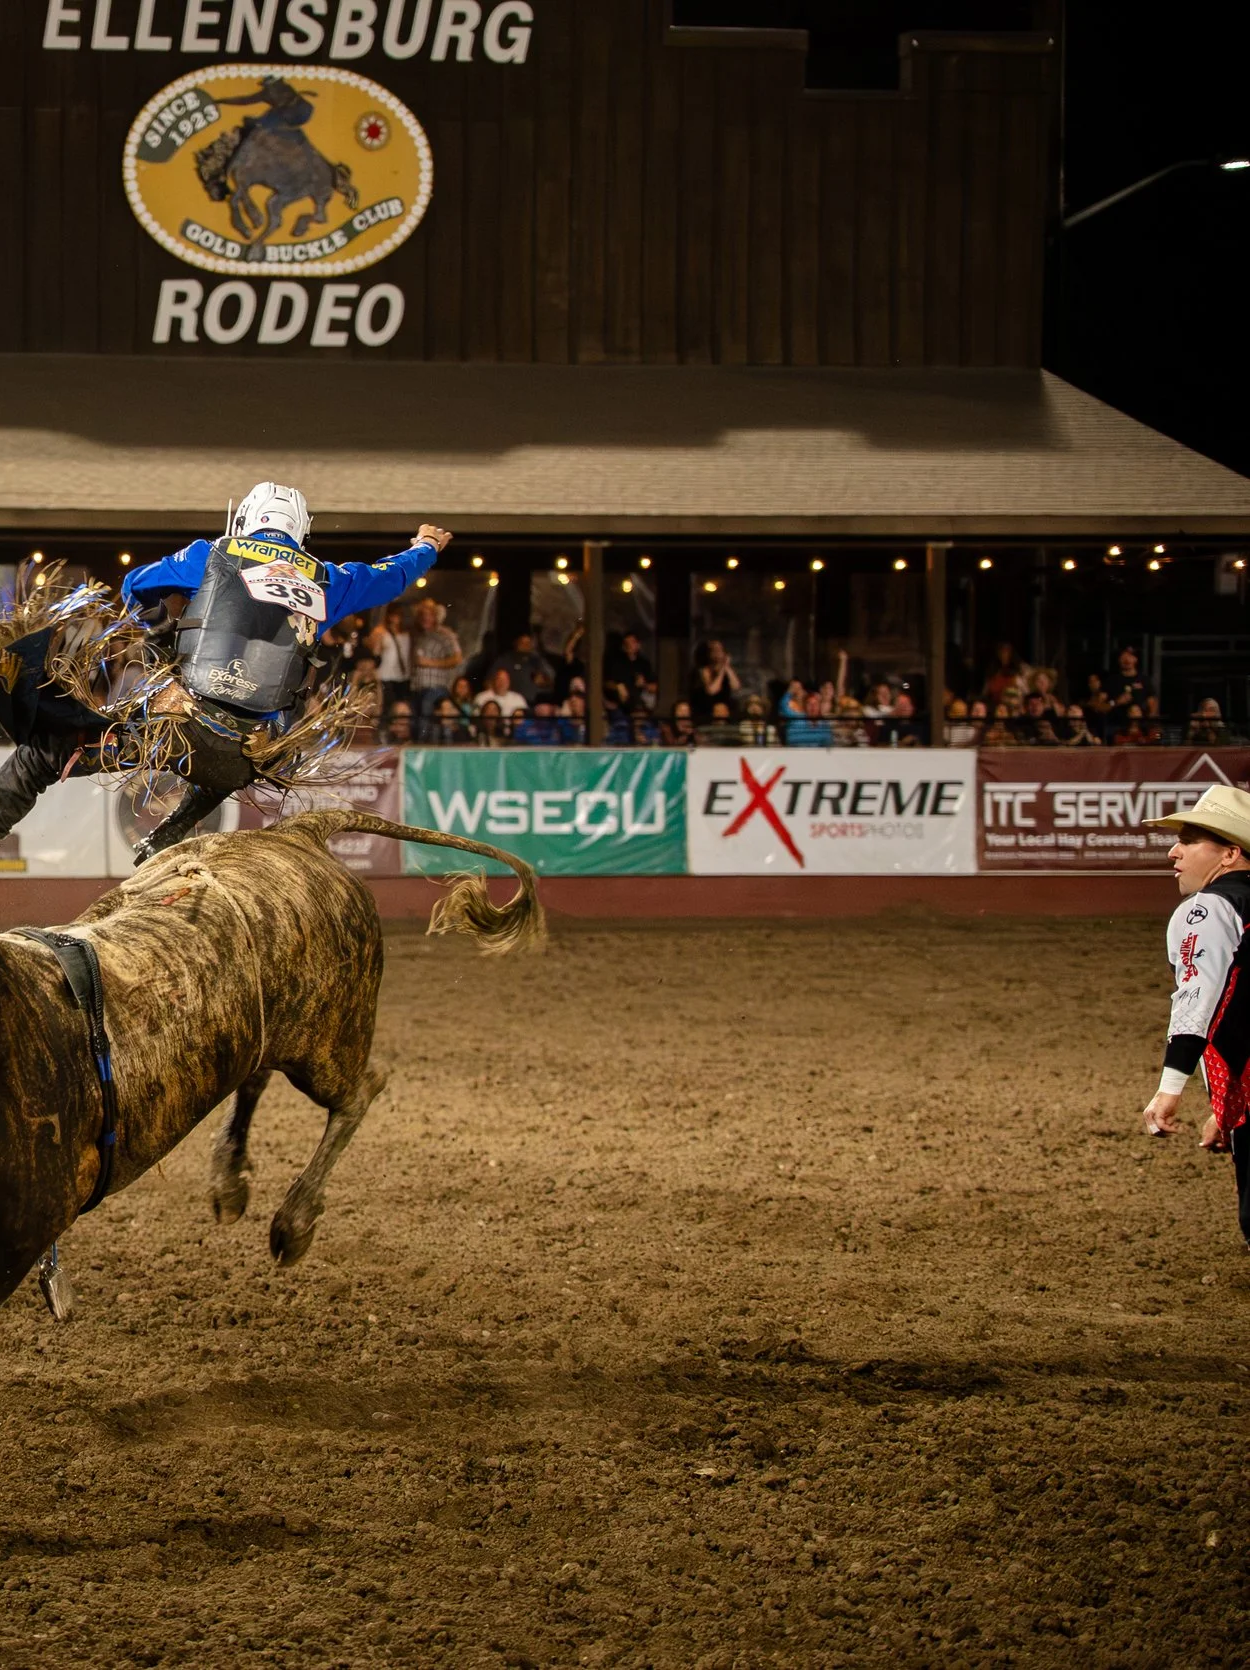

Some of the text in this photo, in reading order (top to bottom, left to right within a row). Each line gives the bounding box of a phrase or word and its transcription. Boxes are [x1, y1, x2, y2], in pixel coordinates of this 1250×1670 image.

[42, 0, 535, 64] ELLENSBURG
[145, 90, 201, 149] SINCE
[168, 104, 221, 147] 1923
[185, 198, 404, 262] GOLD BUCKLE CLUB
[152, 279, 406, 347] RODEO
[236, 540, 313, 570] Wrangler
[248, 578, 322, 594] CONTESTANT
[264, 583, 314, 607] 39
[428, 790, 666, 835] WSECU
[703, 757, 964, 868] EXTREME
[984, 783, 1203, 828] ITC SERVICE
[985, 833, 1016, 847] Your
[1018, 832, 1055, 847] Local
[1058, 833, 1082, 849] Hay
[1086, 832, 1147, 849] Covering
